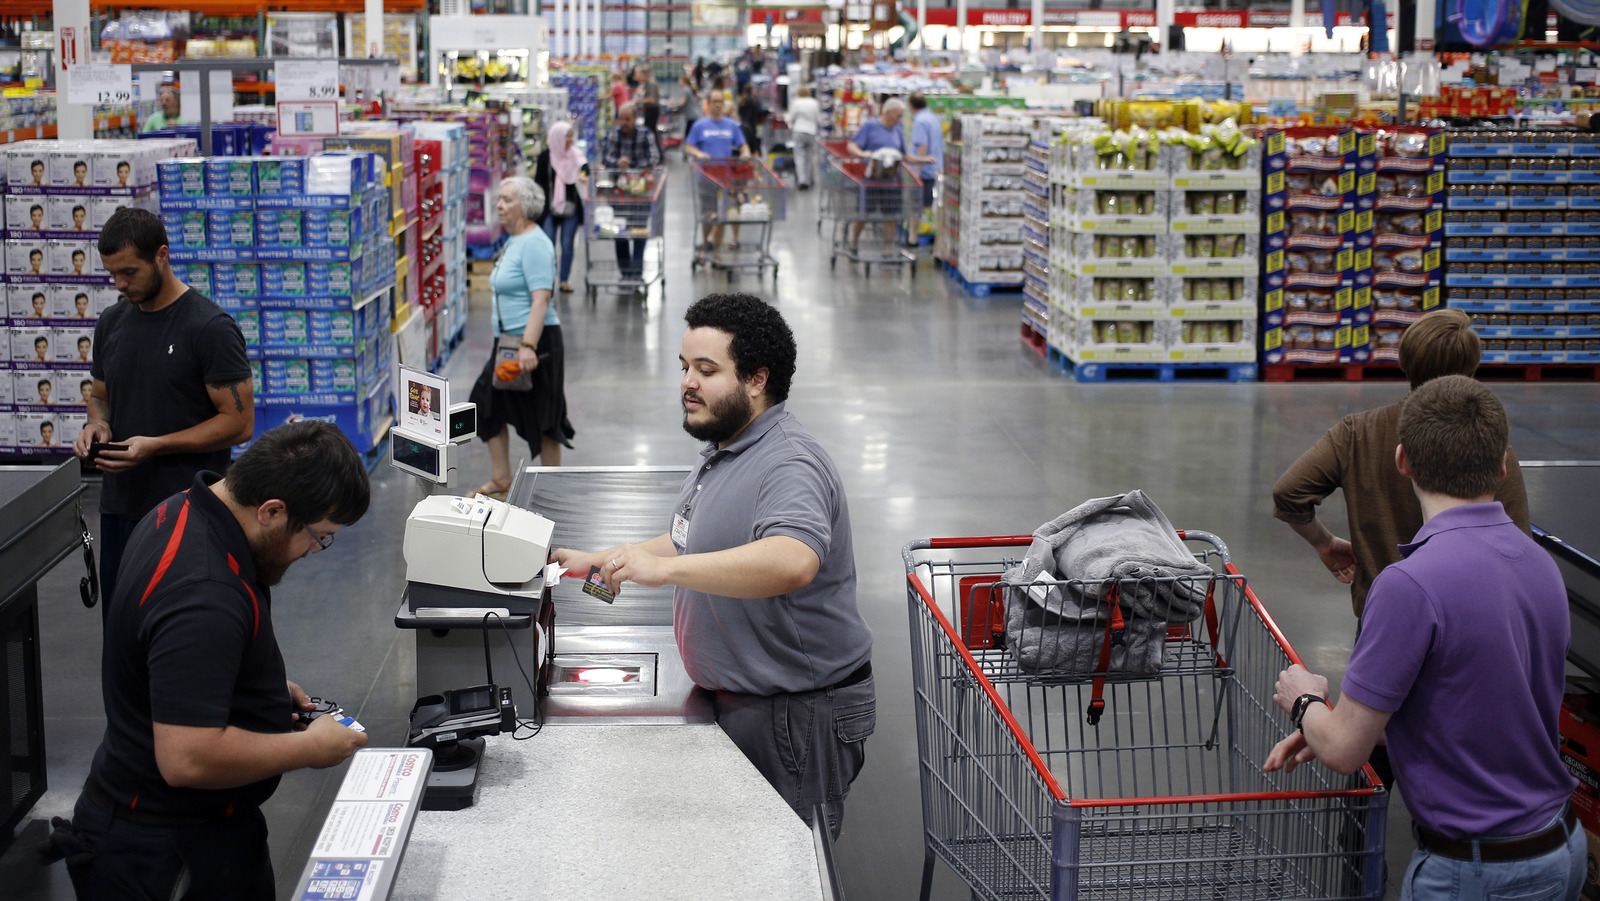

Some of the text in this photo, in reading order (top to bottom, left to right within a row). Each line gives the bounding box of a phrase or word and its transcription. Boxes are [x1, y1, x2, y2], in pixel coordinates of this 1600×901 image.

[983, 12, 1029, 25] POULTRY
[1126, 13, 1155, 26] PORK
[309, 86, 336, 98] 8.99
[98, 91, 130, 103] 12.99
[161, 201, 192, 209] WHITENS
[257, 198, 288, 206] WHITENS
[260, 300, 291, 308] WHITENS
[264, 348, 295, 356] WHITENS
[15, 362, 28, 370] 180
[265, 397, 296, 405] WHITENS
[18, 405, 30, 413] 180
[21, 447, 33, 455] 180
[1564, 754, 1588, 775] ORGANIC
[1587, 776, 1599, 789] BLUE
